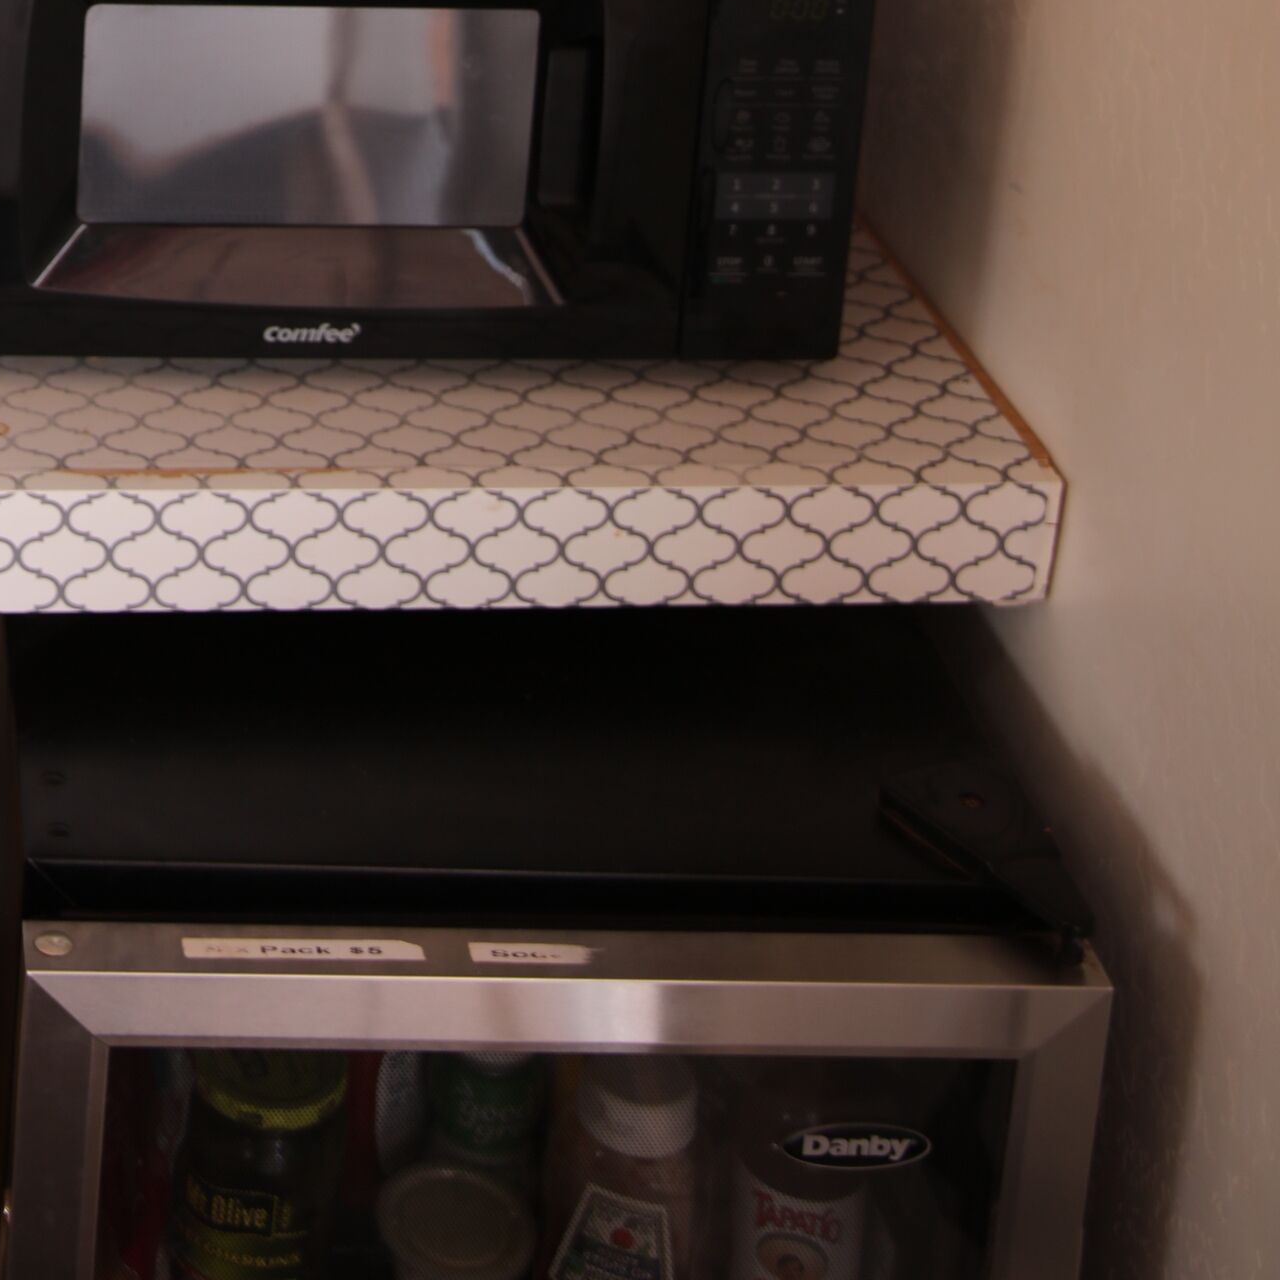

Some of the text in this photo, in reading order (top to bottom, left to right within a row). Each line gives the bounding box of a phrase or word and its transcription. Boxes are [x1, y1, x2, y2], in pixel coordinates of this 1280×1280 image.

[260, 944, 330, 955] Pack
[348, 945, 382, 955] $5
[802, 1134, 910, 1161] Danby
